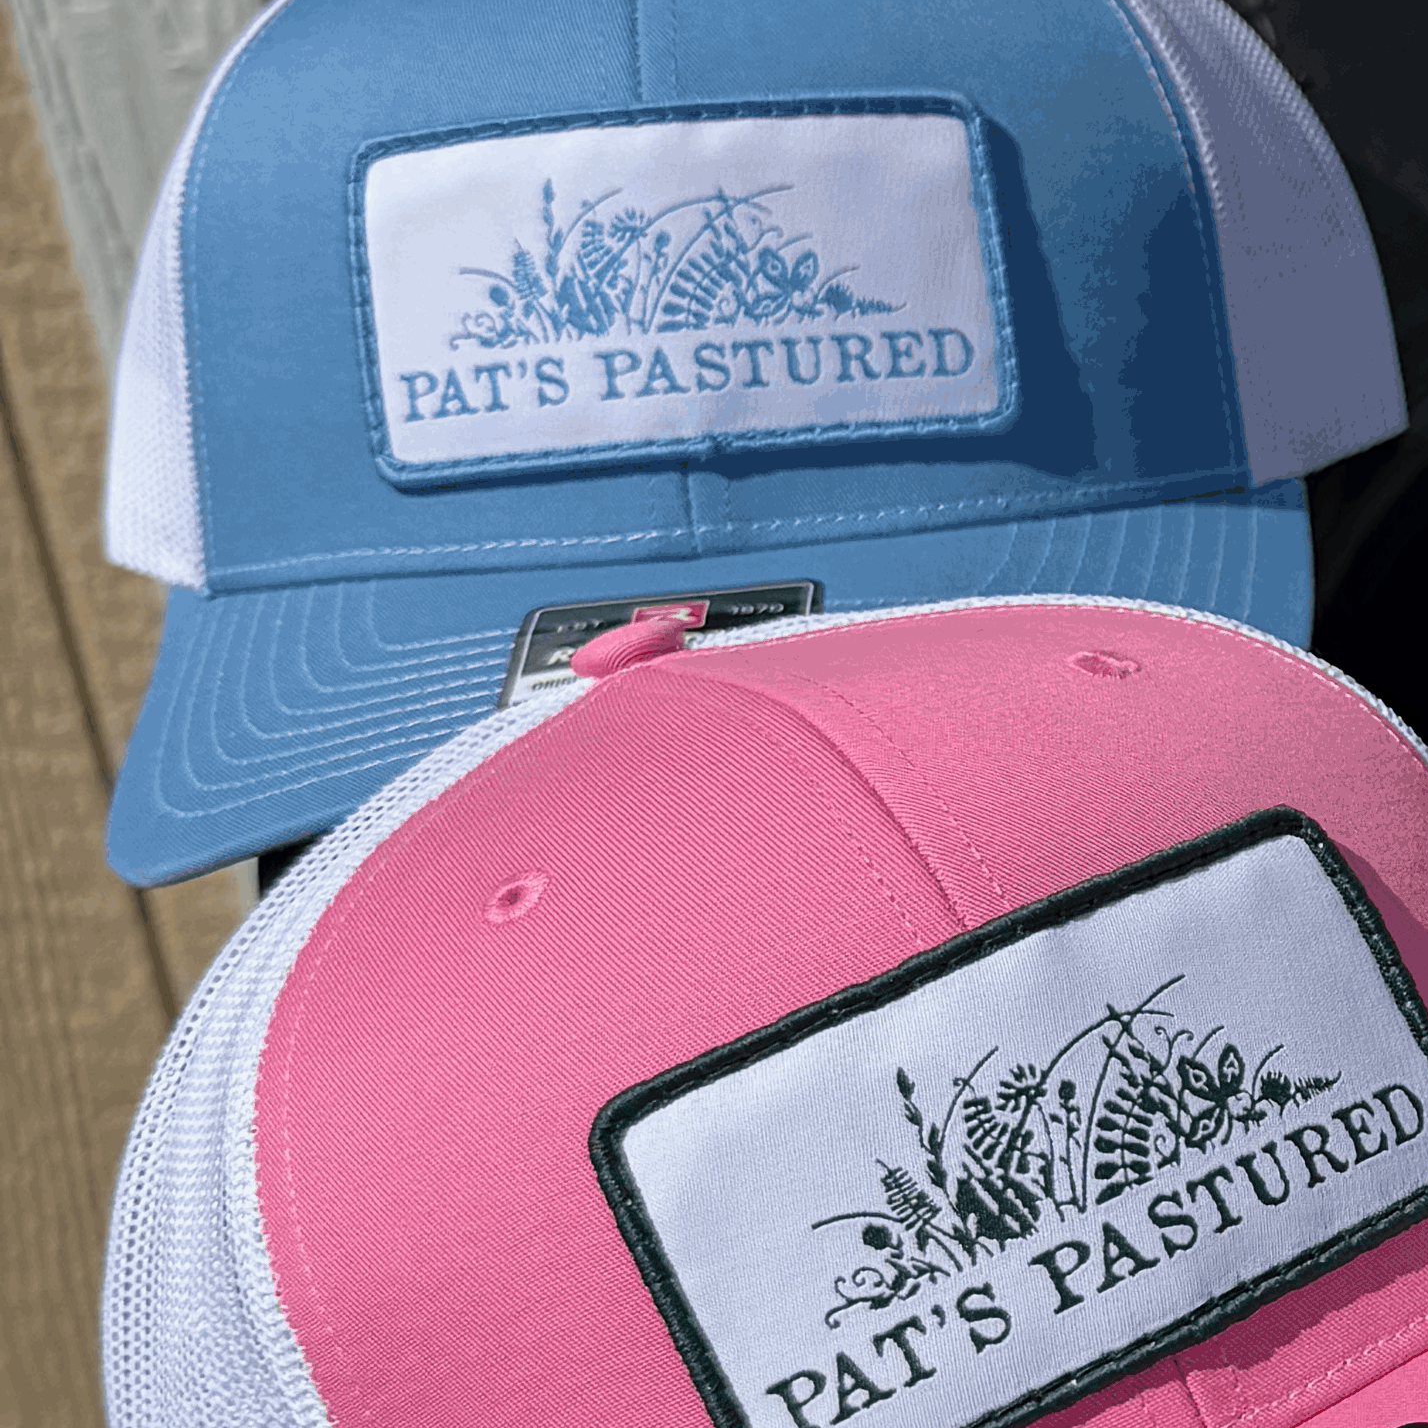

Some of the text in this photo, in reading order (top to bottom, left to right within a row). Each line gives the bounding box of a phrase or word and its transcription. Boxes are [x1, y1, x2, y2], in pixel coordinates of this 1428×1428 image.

[400, 328, 975, 423] PAT'S PASTURED
[1030, 1083, 1426, 1315] PASTURED
